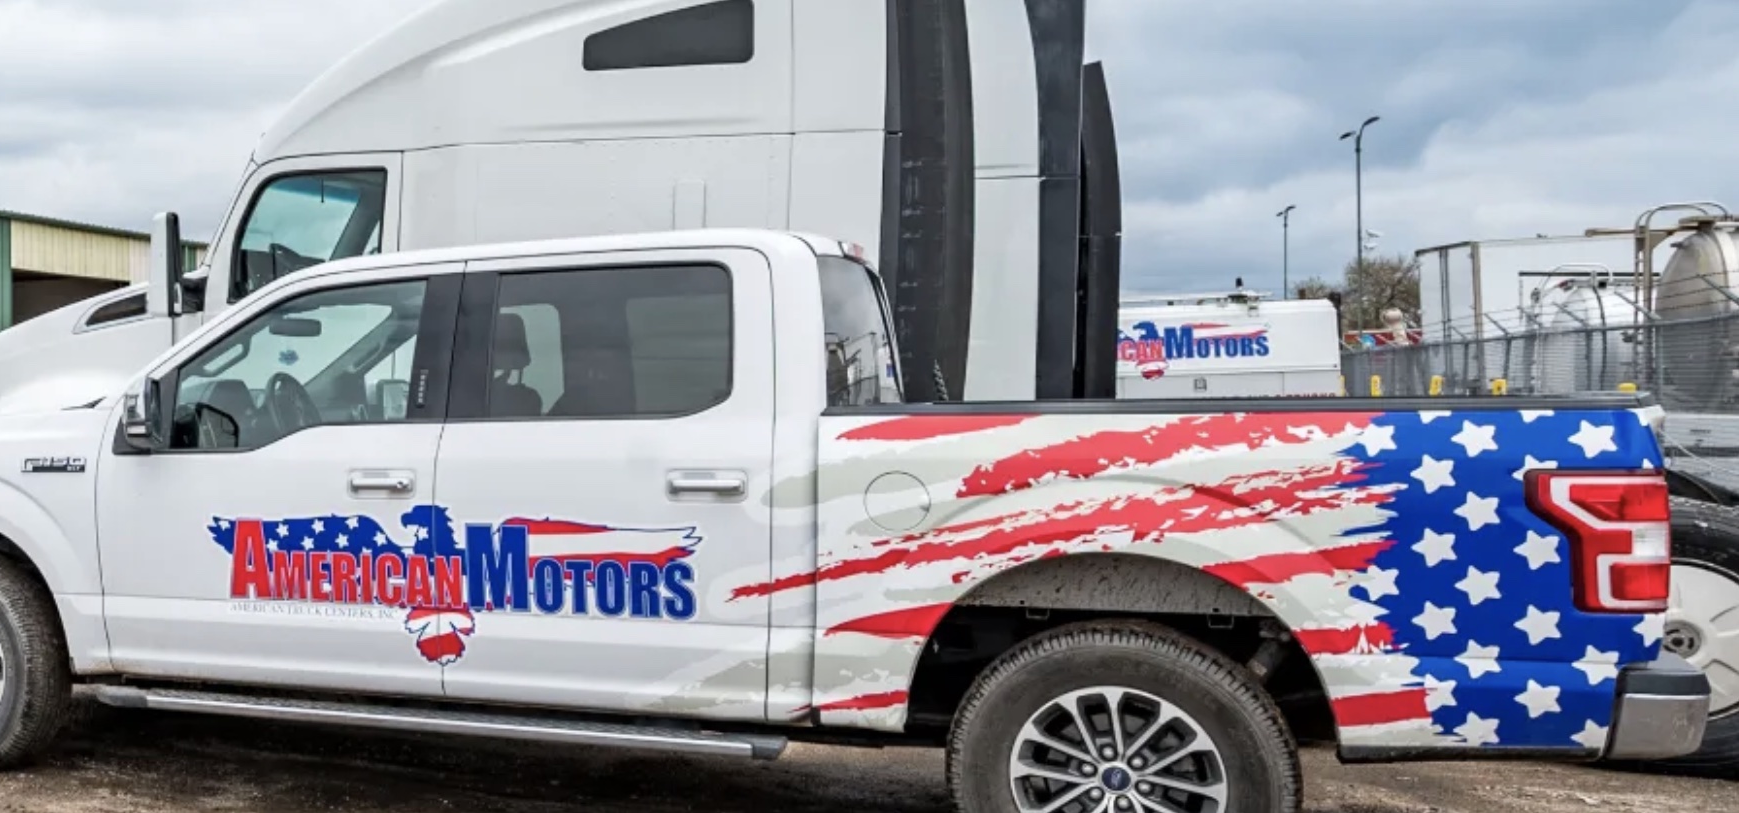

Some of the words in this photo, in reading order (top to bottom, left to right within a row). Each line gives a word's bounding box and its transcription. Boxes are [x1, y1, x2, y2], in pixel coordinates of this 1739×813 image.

[1119, 340, 1164, 361] CAN
[1164, 326, 1269, 359] MOTORS
[230, 518, 463, 608] AMERICAN
[464, 523, 697, 620] MOTORS
[230, 602, 284, 614] AMERICAN
[287, 605, 322, 617] TRUCK
